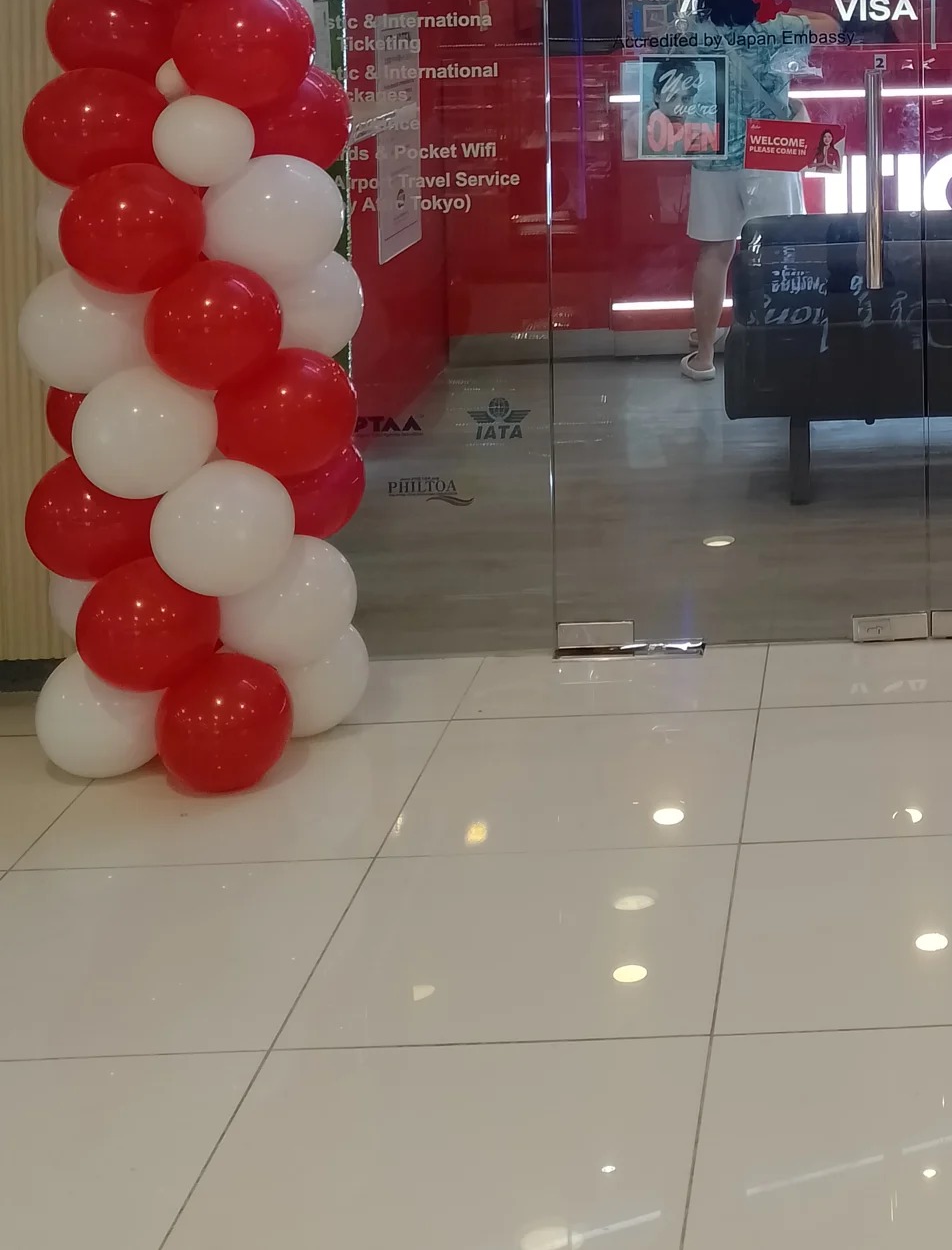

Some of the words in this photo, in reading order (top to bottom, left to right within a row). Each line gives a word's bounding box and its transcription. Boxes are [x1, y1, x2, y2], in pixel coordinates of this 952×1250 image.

[363, 14, 377, 29] &
[336, 34, 421, 53] Ticketing
[612, 33, 698, 50] Accredited
[703, 32, 722, 50] by
[727, 31, 776, 49] Japan
[783, 29, 855, 47] Embassy
[364, 64, 377, 80] &
[384, 62, 499, 80] International
[875, 57, 885, 69] 2
[659, 68, 706, 102] Yes
[647, 108, 721, 153] OPEN
[394, 142, 458, 161] Pocket
[460, 141, 498, 158] Wifi
[749, 134, 808, 150] WELCOME,
[749, 145, 775, 154] PLEASE
[776, 147, 797, 155] COME
[798, 148, 807, 156] IN
[400, 172, 451, 188] Travel
[456, 170, 521, 188] Service
[412, 193, 472, 214] Tokyo)
[475, 424, 523, 440] IATA
[388, 479, 458, 495] PHILTOA
